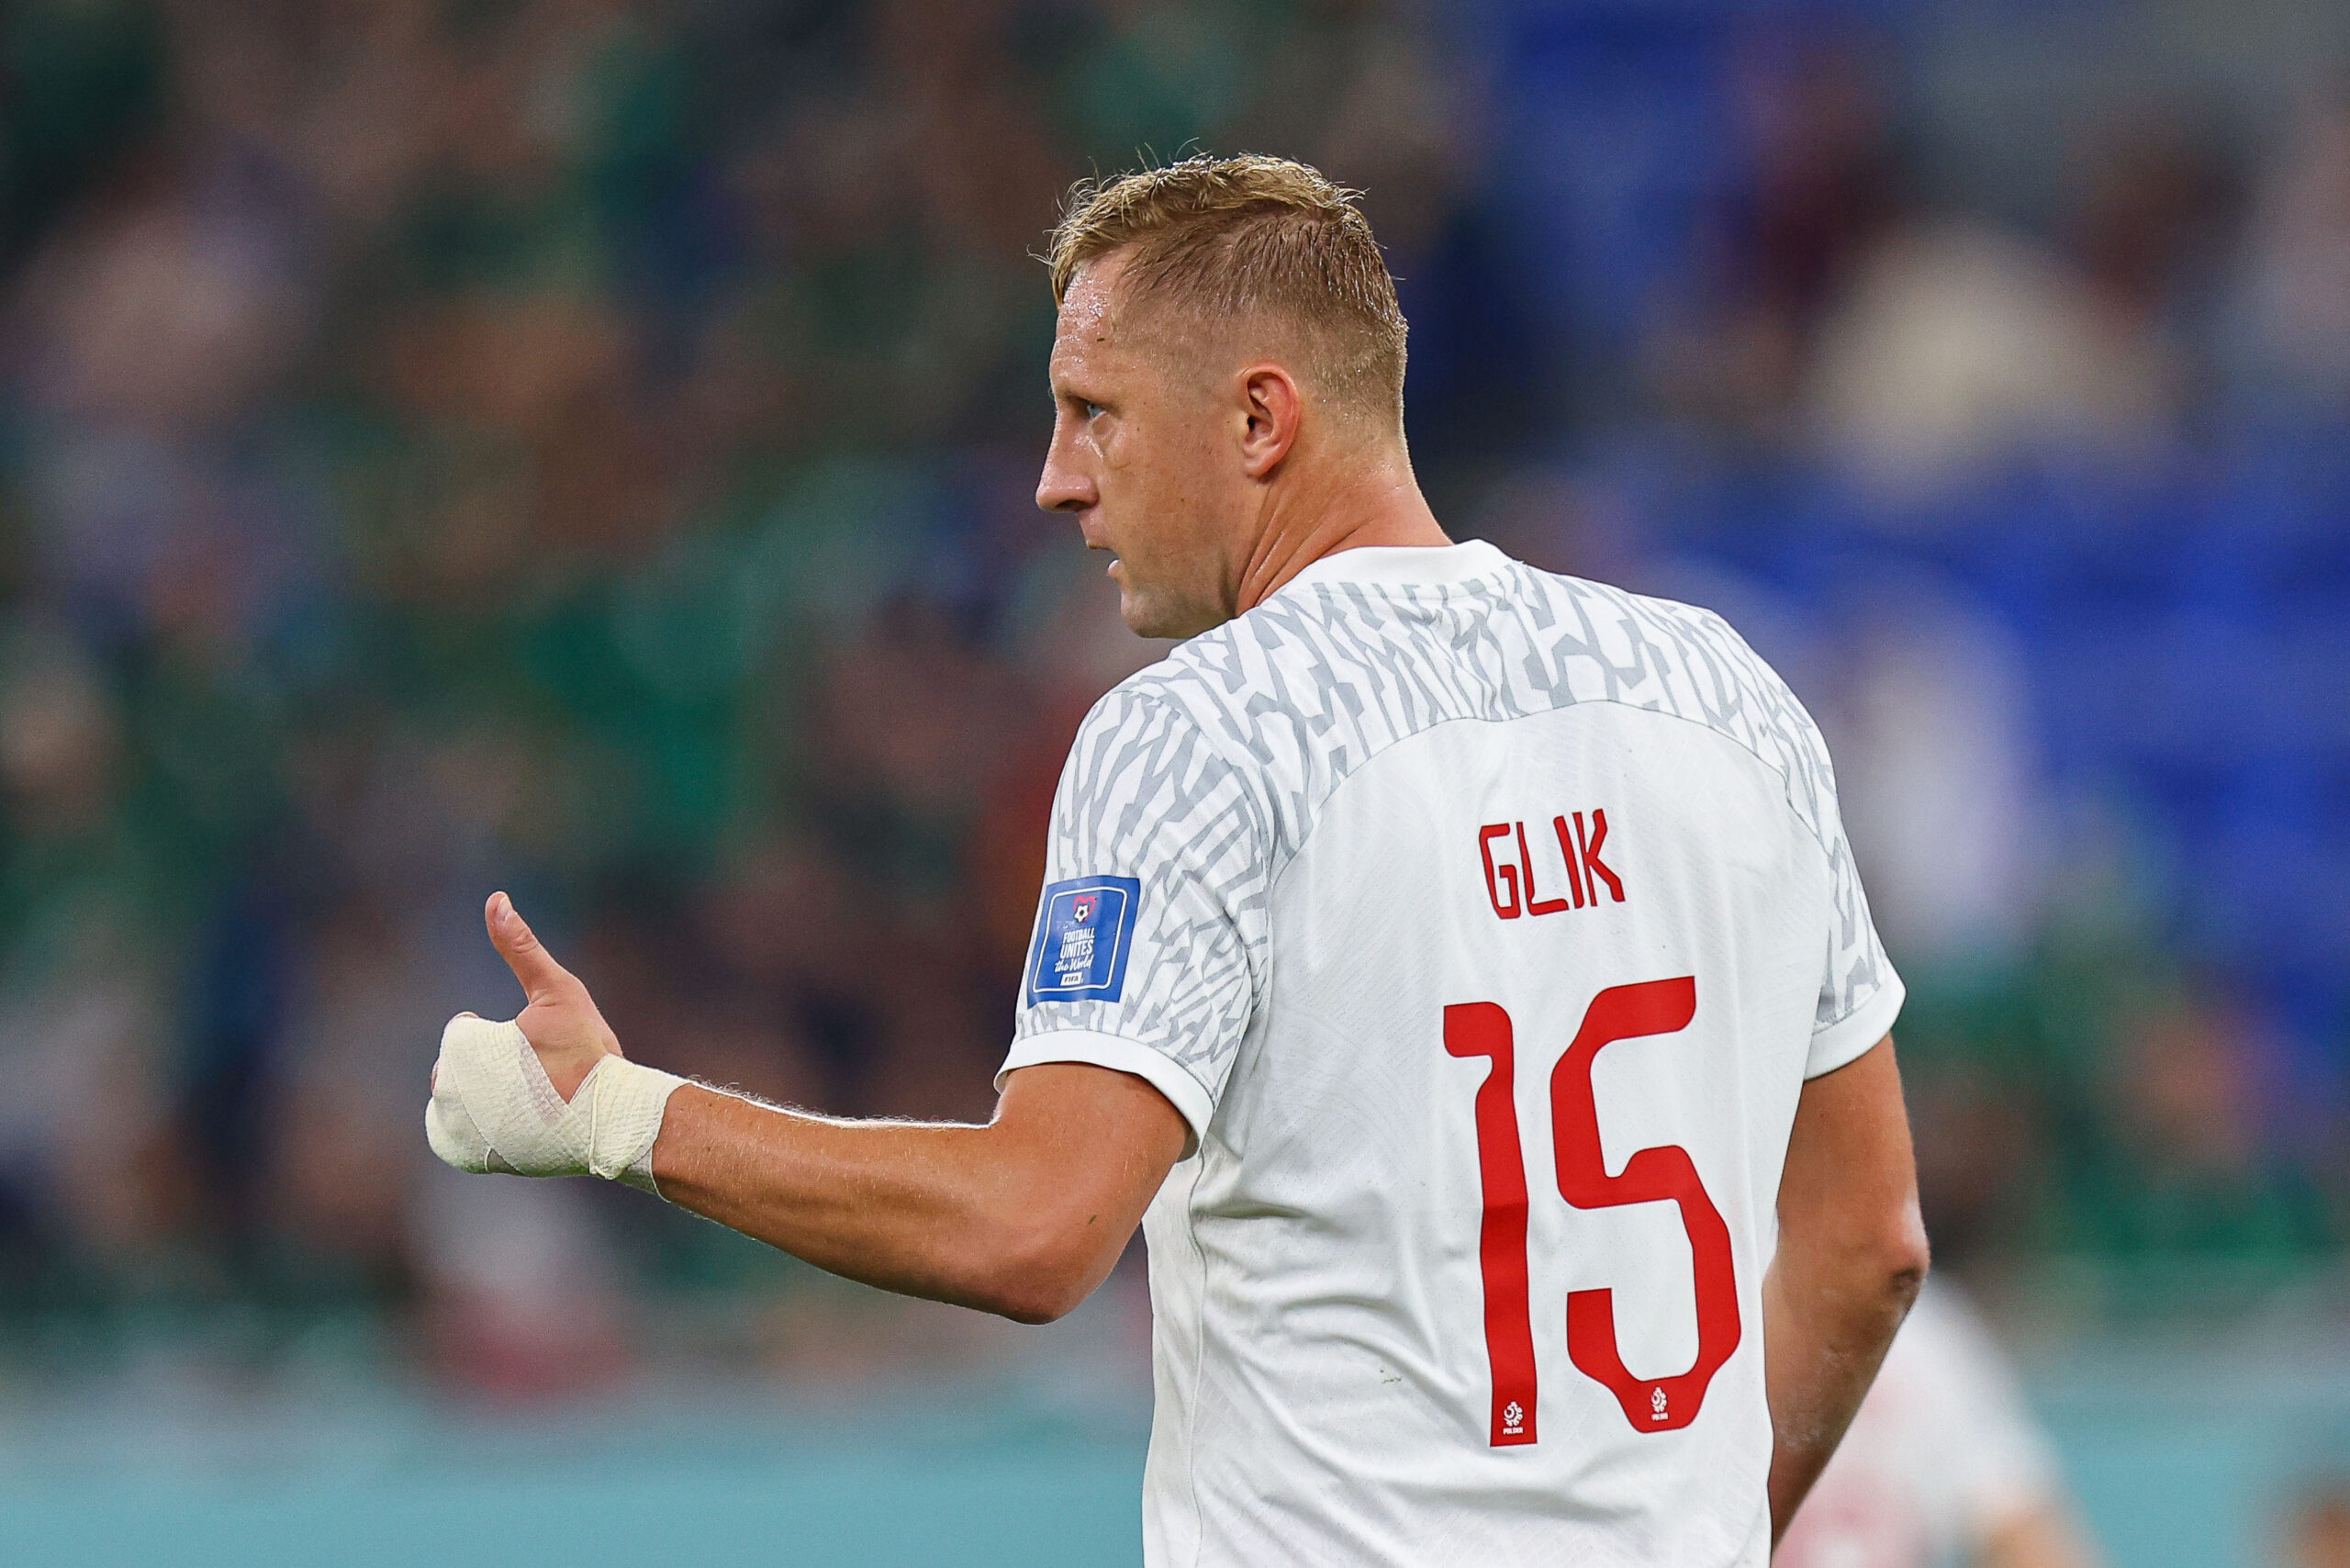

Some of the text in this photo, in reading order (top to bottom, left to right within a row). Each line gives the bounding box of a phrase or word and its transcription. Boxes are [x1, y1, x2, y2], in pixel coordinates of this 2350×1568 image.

[1479, 808, 1626, 920] GLIK
[1063, 927, 1095, 944] FOOTBALL
[1059, 939, 1094, 959] UNITES
[1054, 955, 1094, 973] the World
[1064, 975, 1080, 983] FIFA
[1443, 976, 1741, 1446] 15
